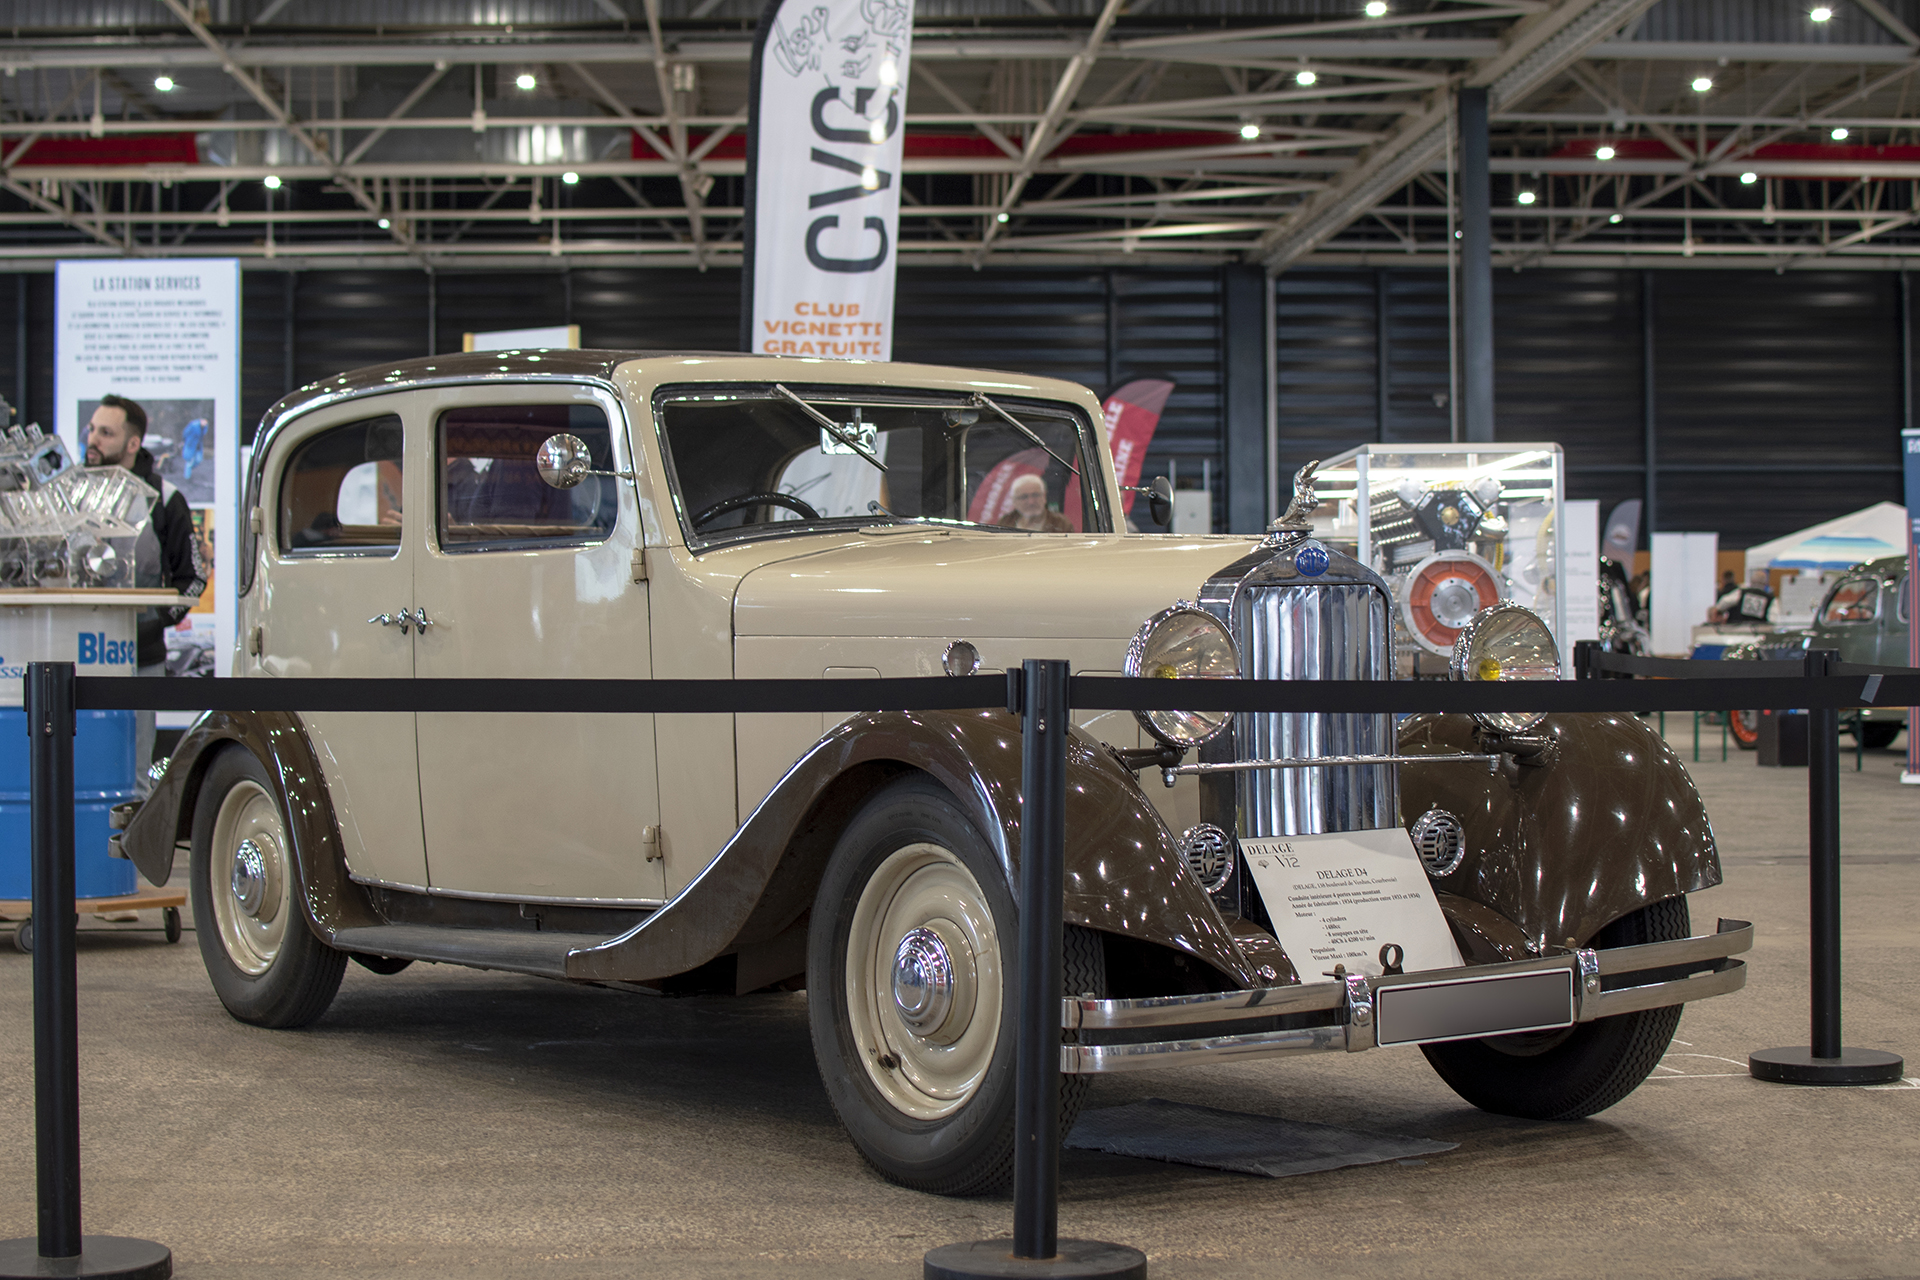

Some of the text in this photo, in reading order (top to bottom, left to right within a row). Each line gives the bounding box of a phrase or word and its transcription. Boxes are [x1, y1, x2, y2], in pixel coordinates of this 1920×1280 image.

[805, 86, 899, 273] CVG
[93, 275, 201, 291] LA STATION SERVICES
[794, 302, 860, 317] CLUB
[1247, 843, 1294, 855] DELAGE
[1316, 867, 1368, 880] DELAGE D4
[1336, 891, 1351, 899] portes
[1353, 896, 1380, 905] (production
[1332, 930, 1353, 938] soupapes
